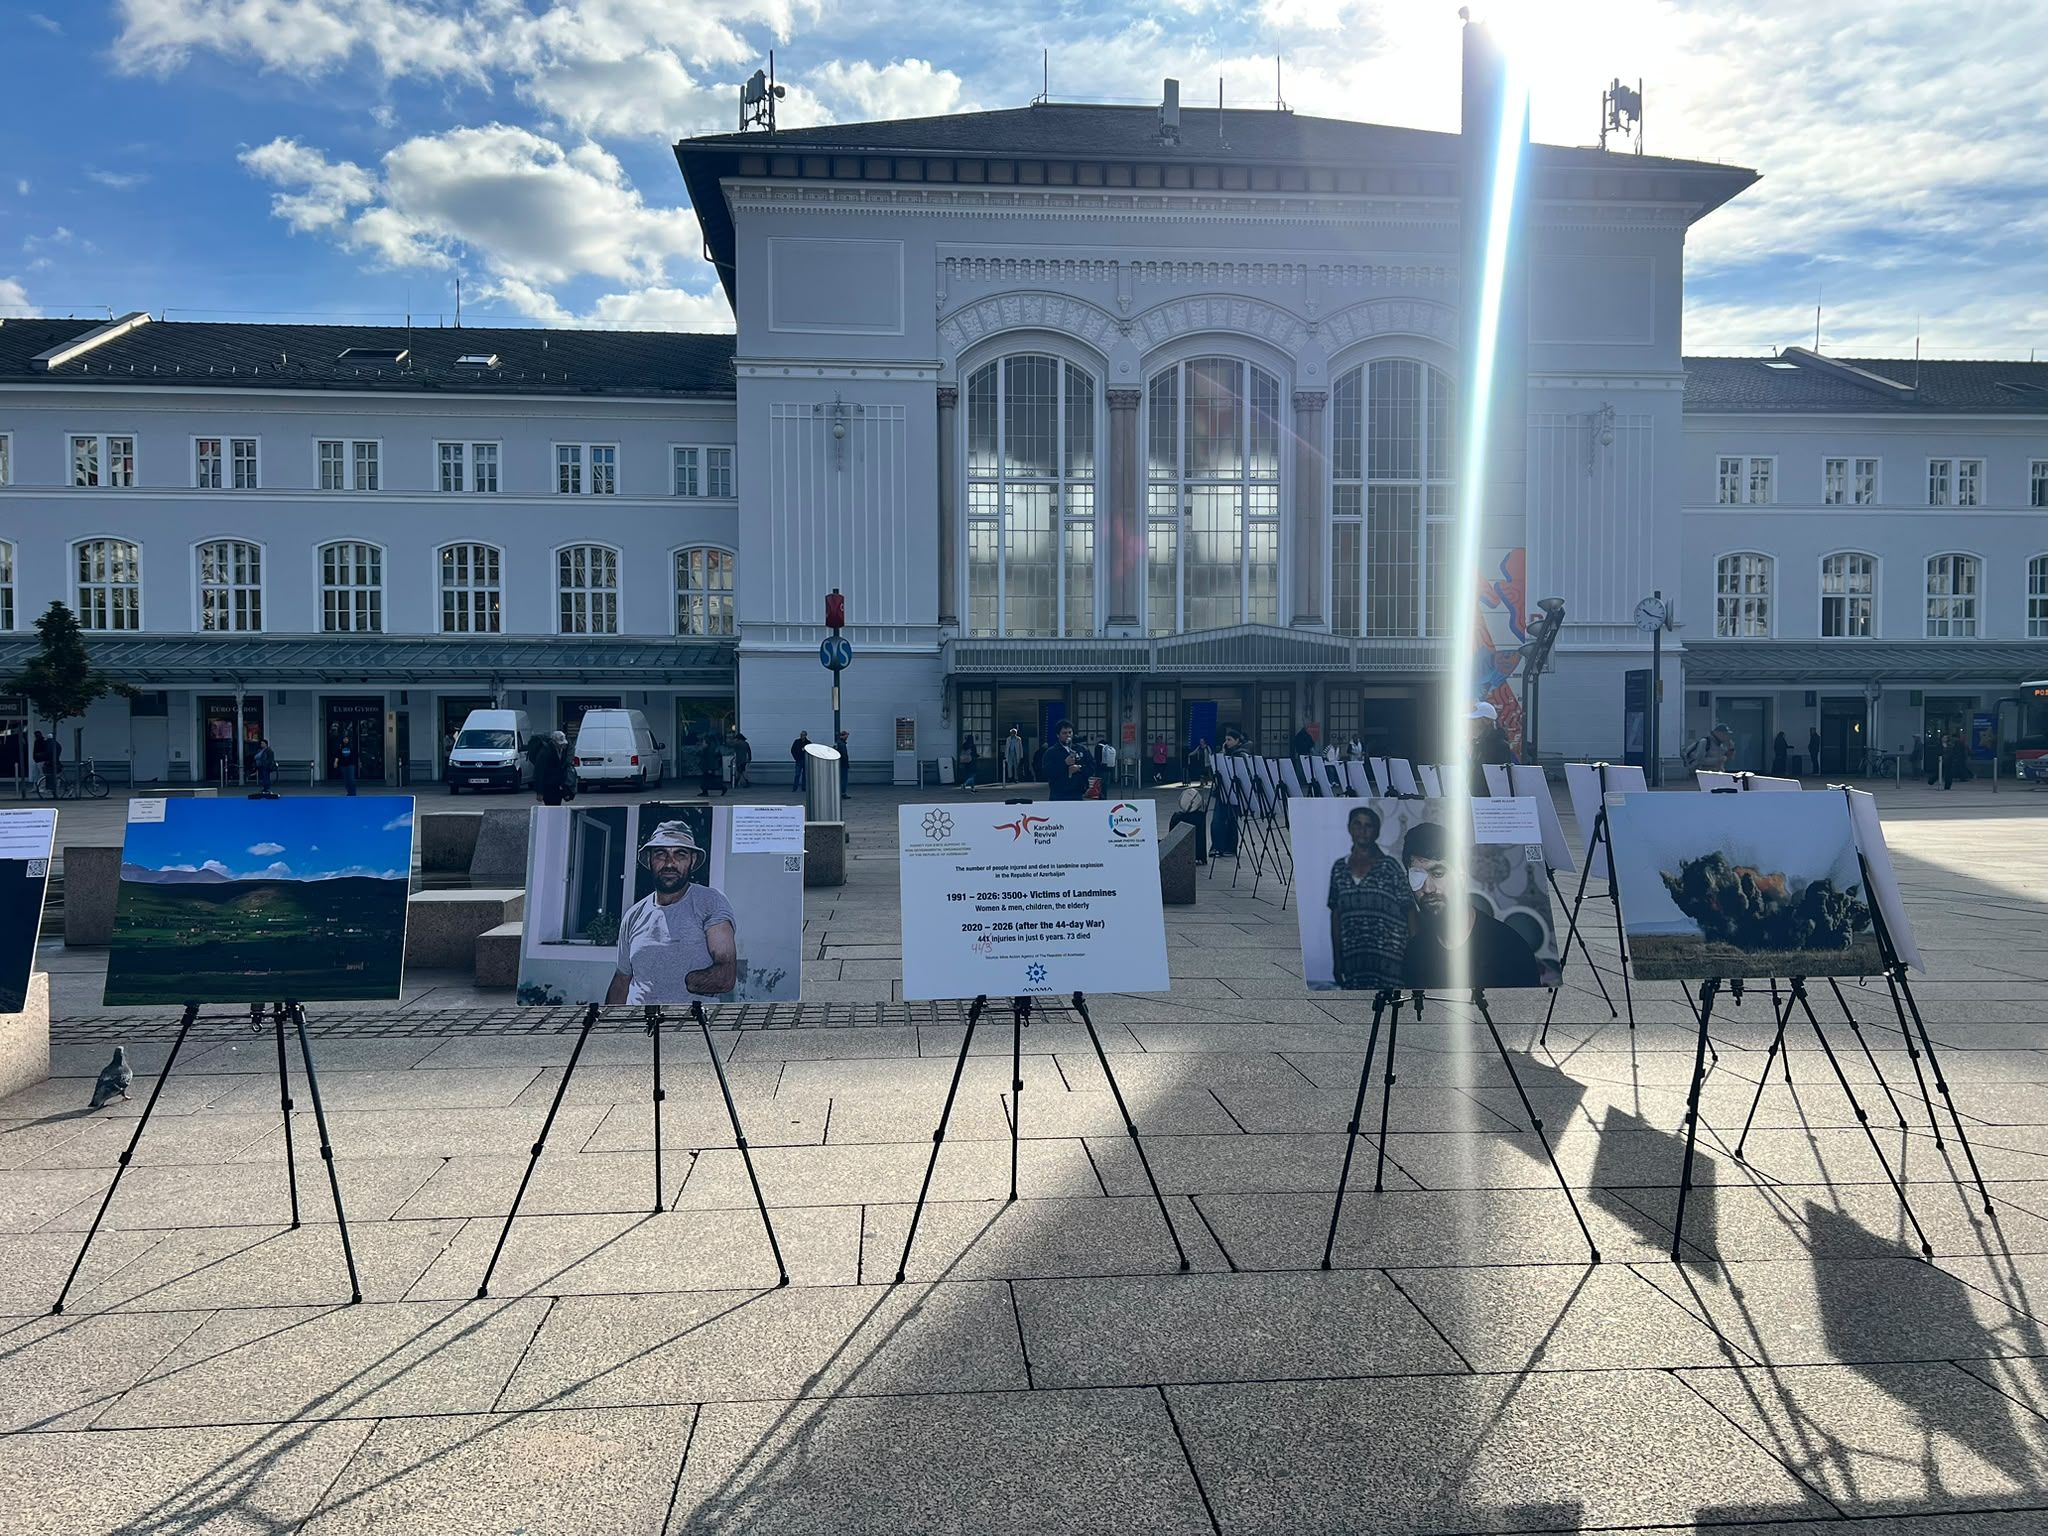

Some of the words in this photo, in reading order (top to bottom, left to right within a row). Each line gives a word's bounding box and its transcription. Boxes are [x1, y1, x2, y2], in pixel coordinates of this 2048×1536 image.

[839, 640, 848, 666] S
[1030, 891, 1060, 899] Victims
[1073, 889, 1116, 898] Landmines
[1016, 922, 1038, 930] (after
[1056, 921, 1084, 929] 44-day
[1086, 920, 1104, 928] War)
[992, 935, 1016, 943] injuries
[1026, 934, 1038, 942] just
